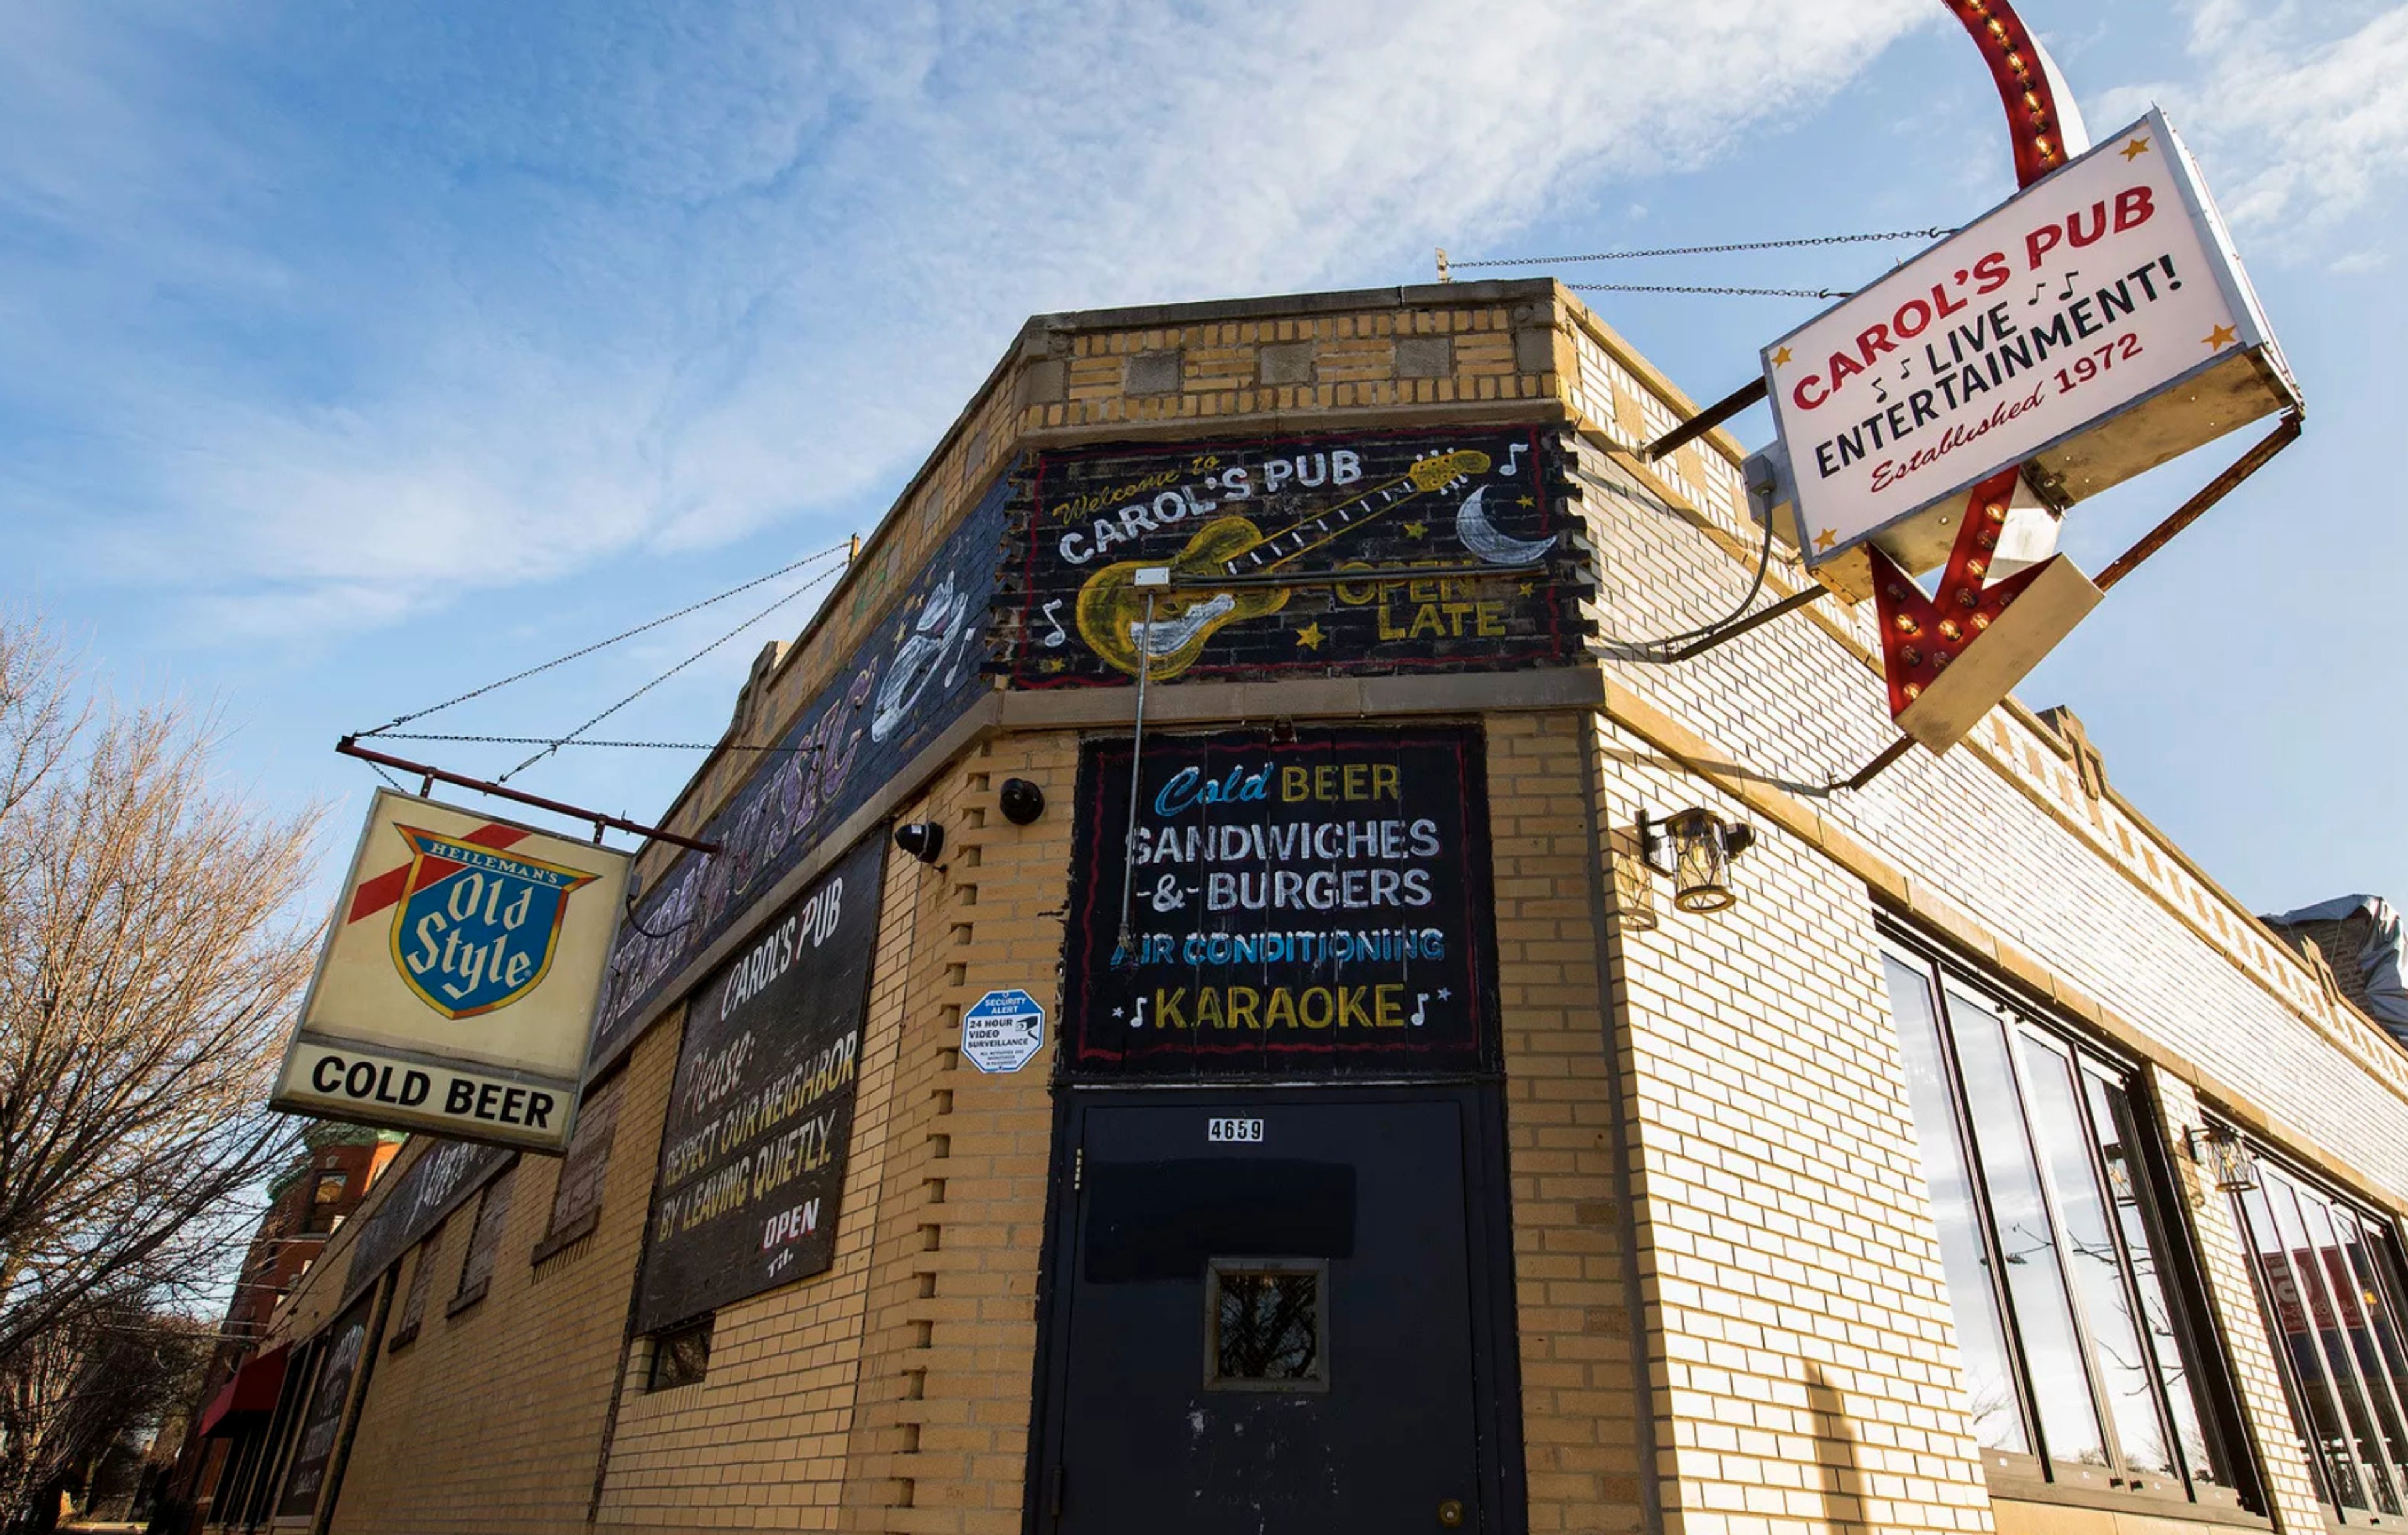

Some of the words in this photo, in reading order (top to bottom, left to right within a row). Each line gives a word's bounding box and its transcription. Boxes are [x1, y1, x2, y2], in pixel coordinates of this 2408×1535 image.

[1793, 251, 2010, 410] CAROL'S
[2025, 186, 2155, 270] PUB
[1926, 302, 2016, 374] LIVE
[1815, 253, 2184, 479] ENTERTAINMENT!
[1871, 381, 2046, 493] Established
[2054, 333, 2143, 395] 1972
[1053, 468, 1180, 525] Welcome
[1192, 455, 1219, 475] to
[1059, 468, 1252, 565] CAROL'S
[1264, 450, 1362, 492] PUB
[1378, 601, 1506, 641] LATE
[1154, 761, 1274, 816] Cold
[1281, 762, 1400, 803] BEER
[431, 841, 558, 884] HEILEMAN'S
[1124, 818, 1440, 865] SANDWICHES
[447, 872, 534, 931] Old
[1207, 868, 1434, 912] BURGERS
[406, 911, 532, 1000] Style
[722, 915, 796, 1021] CAROL'S
[796, 877, 843, 961] PUB
[1182, 927, 1444, 966] CONDITIONING
[969, 1020, 982, 1029] 24
[984, 1018, 1013, 1028] HOUR
[984, 997, 1027, 1007] SECURITY
[991, 1005, 1018, 1015] ALERT
[1154, 983, 1406, 1030] KARAOKE
[968, 1029, 1000, 1039] VIDEO
[968, 1037, 1028, 1048] SURVEILLANCE
[312, 1055, 431, 1107] COLD
[445, 1078, 554, 1129] BEER
[663, 1119, 721, 1188] RESPECT
[721, 1095, 760, 1155] OUR
[759, 1029, 858, 1129] NEIGHBOR
[1211, 1120, 1261, 1140] 4659
[658, 1195, 681, 1243] BY
[682, 1156, 751, 1232] LEAVING
[763, 1197, 820, 1250] OPEN
